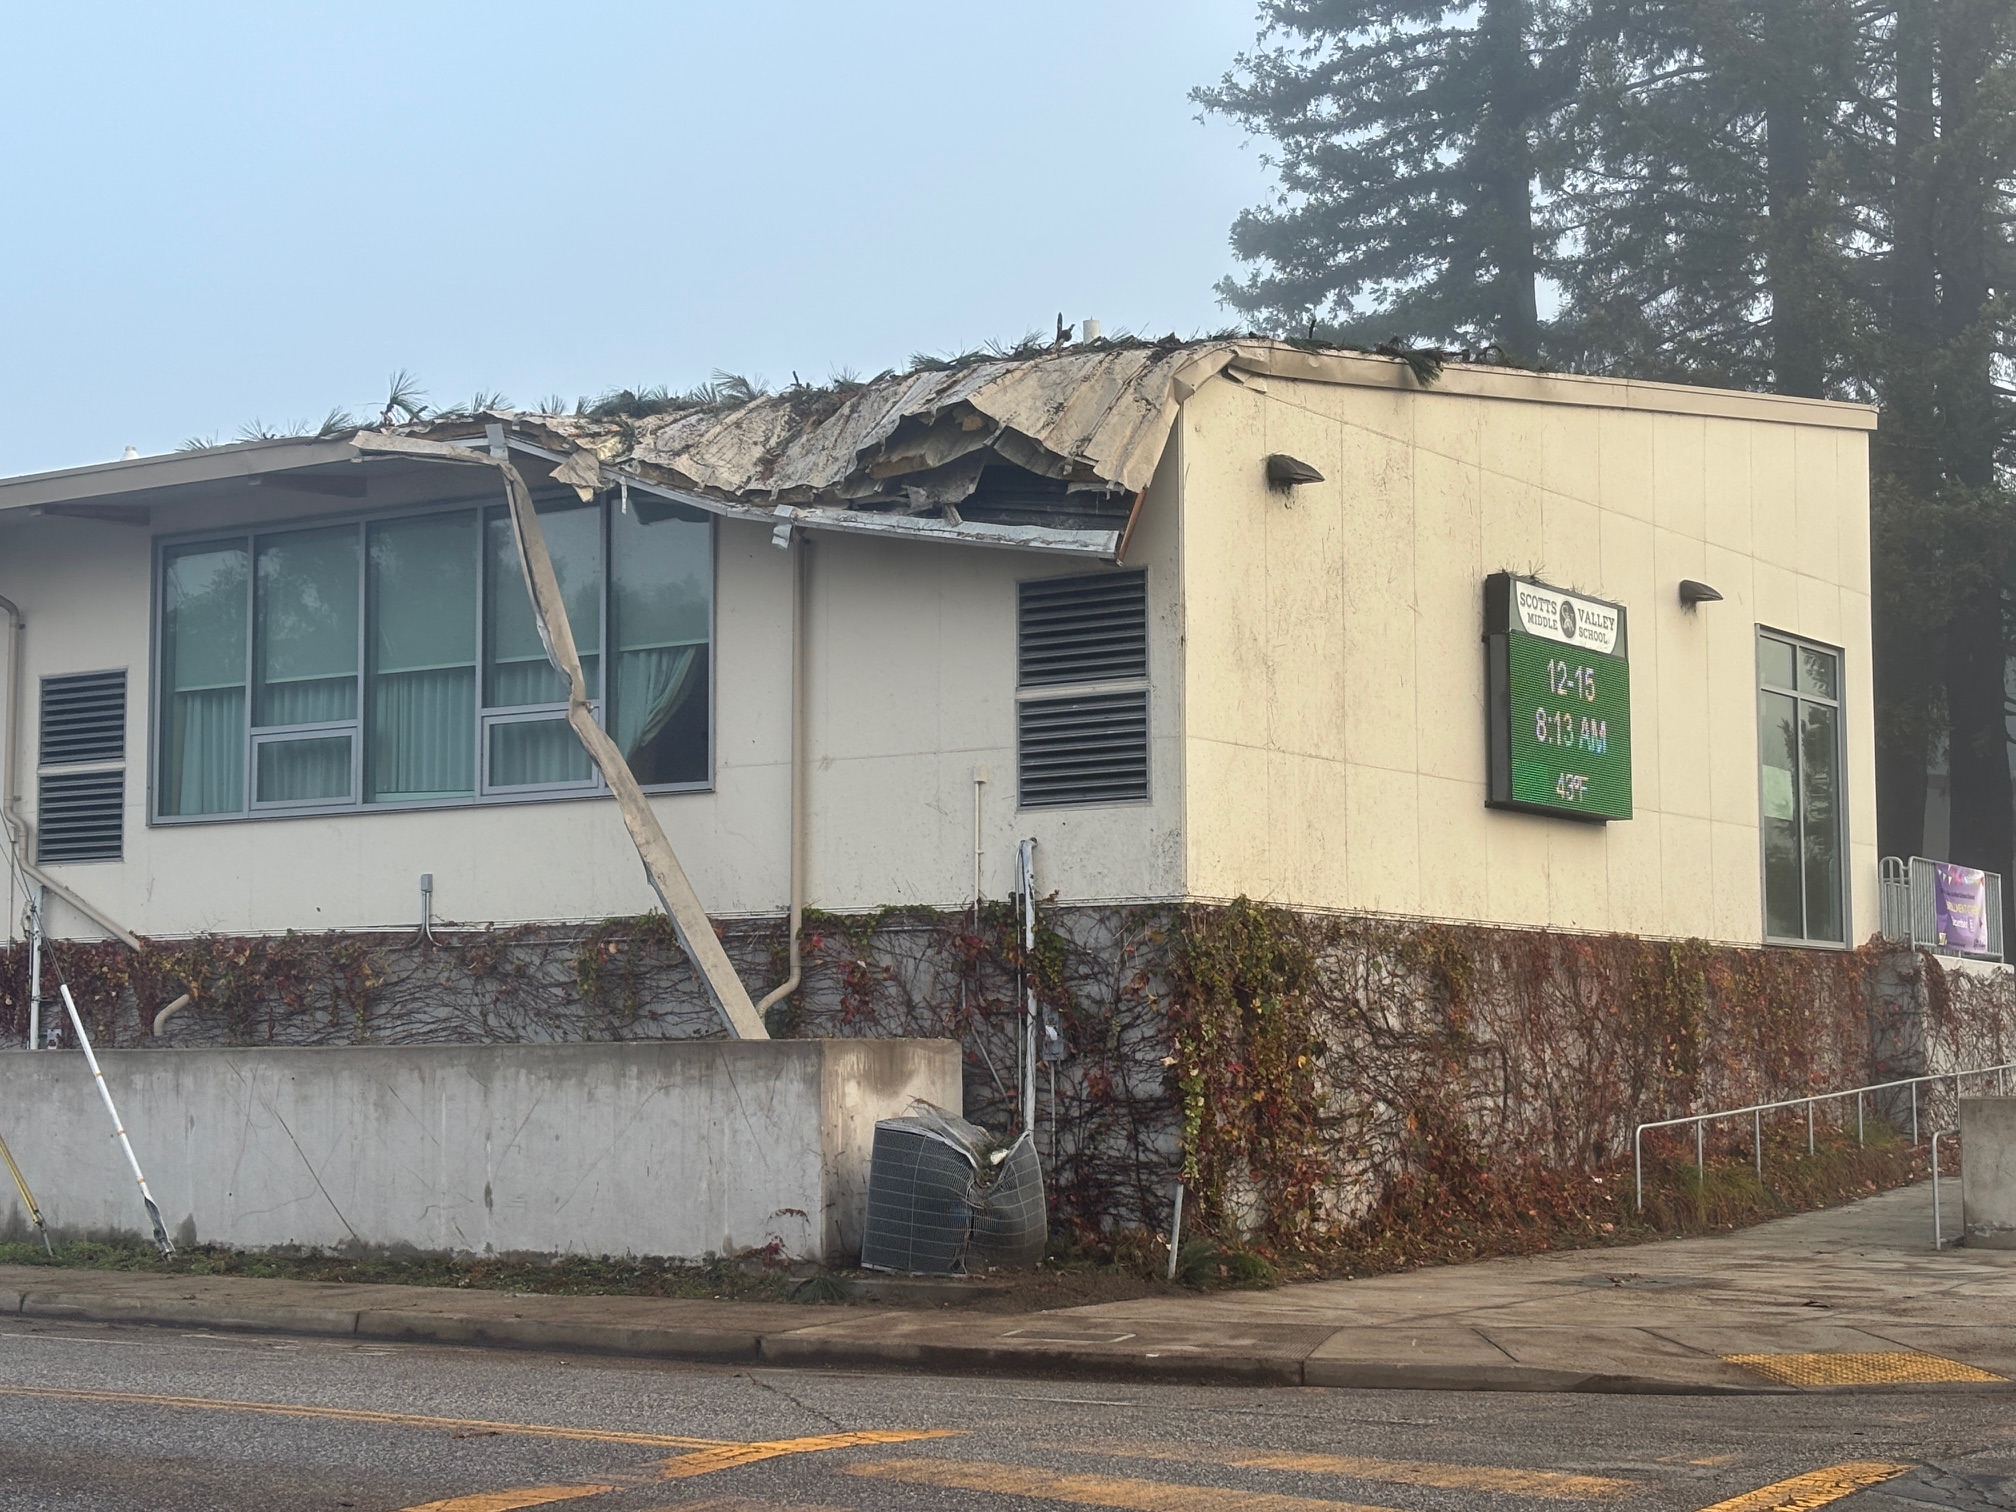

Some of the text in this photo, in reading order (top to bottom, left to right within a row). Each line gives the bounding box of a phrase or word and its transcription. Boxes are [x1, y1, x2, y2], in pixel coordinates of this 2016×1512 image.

[1519, 592, 1615, 631] SCOTTS VALLEY
[1527, 612, 1608, 644] MIDDLE SCHOOL
[1547, 659, 1596, 702] 12-15
[1535, 707, 1607, 755] 8:13 AM
